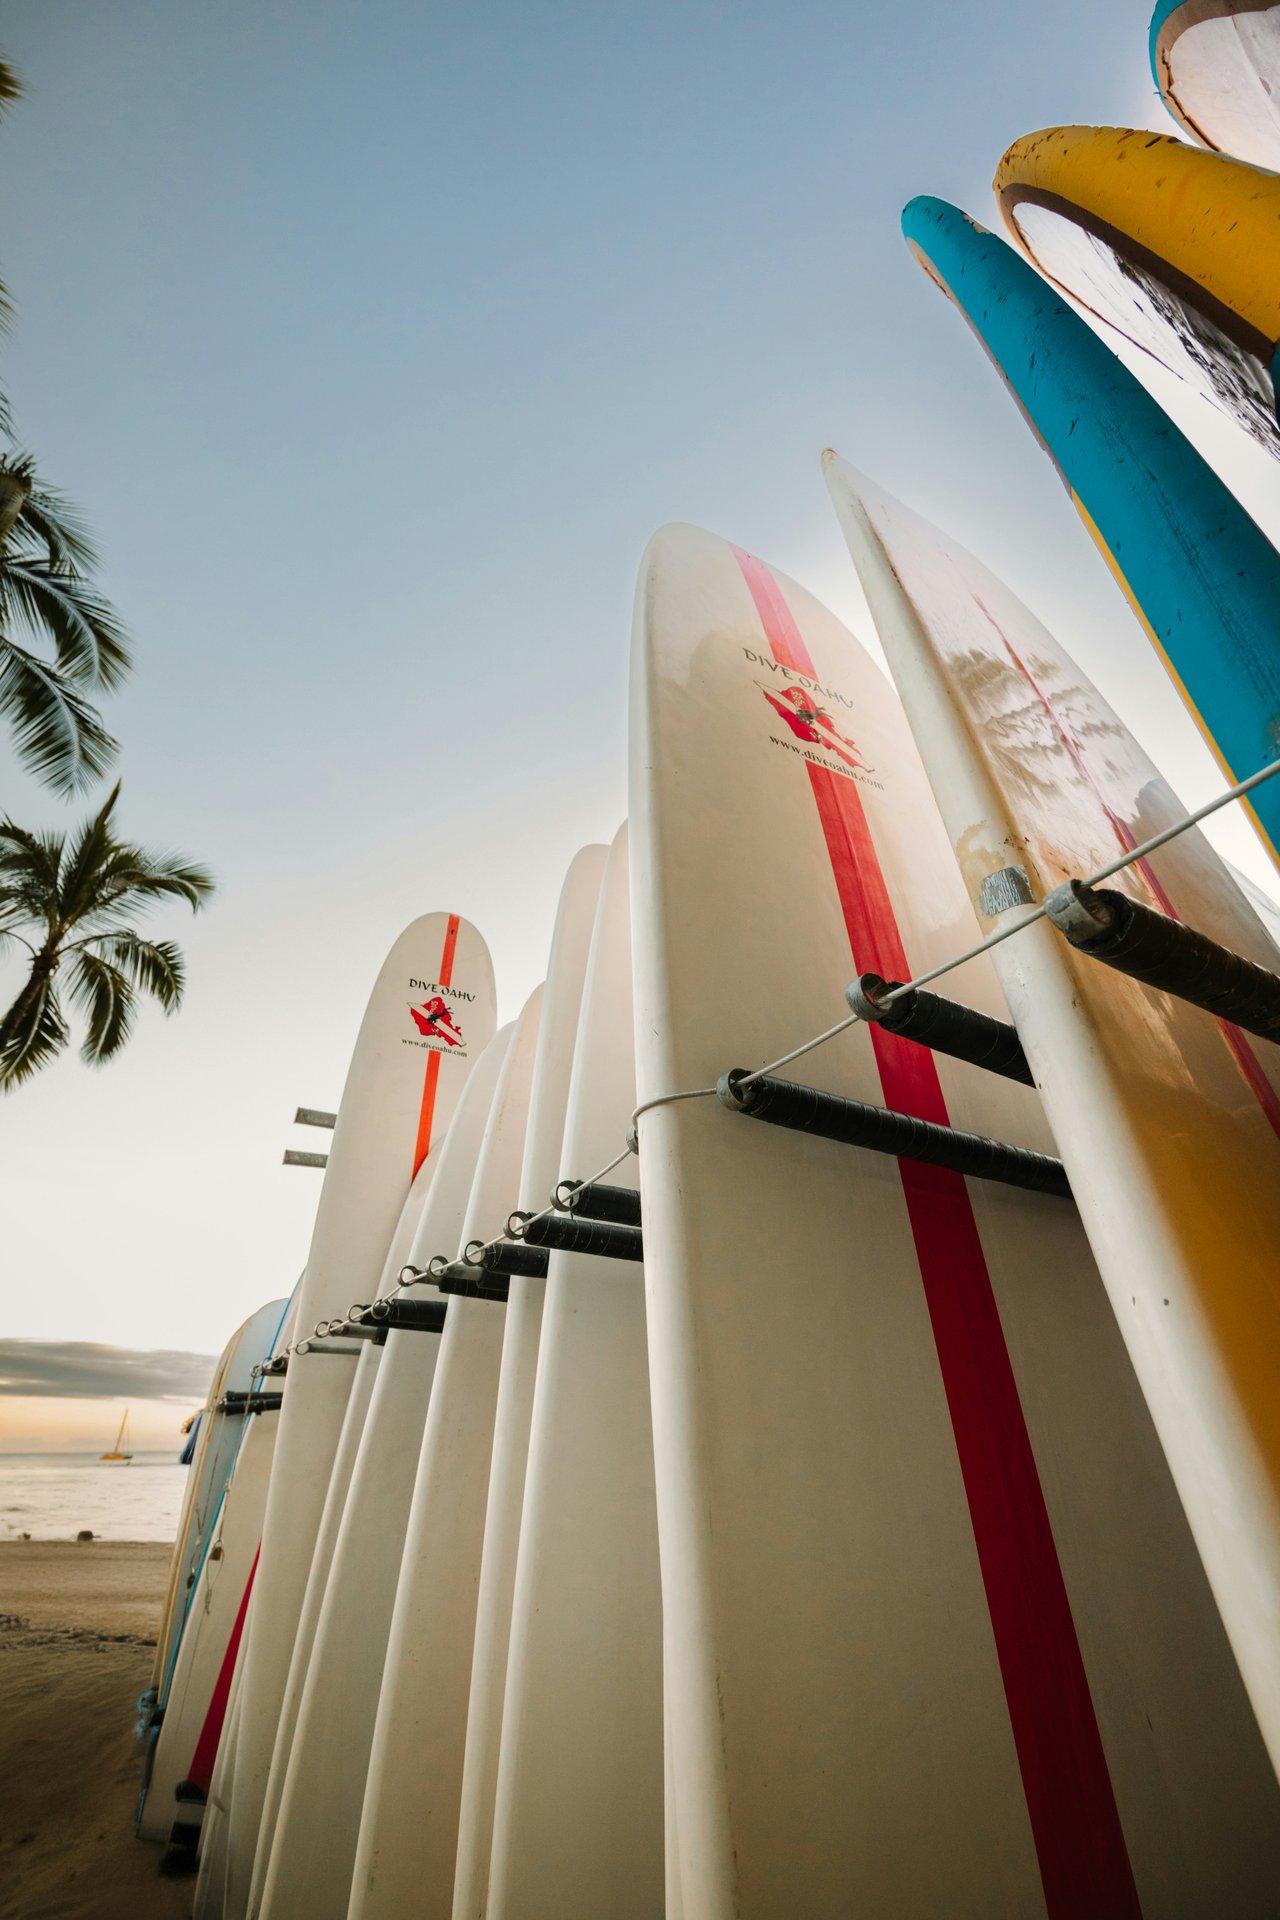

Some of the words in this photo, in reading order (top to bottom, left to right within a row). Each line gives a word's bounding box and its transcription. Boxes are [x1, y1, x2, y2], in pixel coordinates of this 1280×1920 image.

[742, 648, 794, 681] DIVE
[798, 676, 854, 709] OAHU
[769, 735, 885, 791] www.diveoahu.com
[409, 978, 438, 993] DIVE
[441, 986, 476, 1003] OAHU
[401, 1038, 468, 1058] www.diveoahu.com
